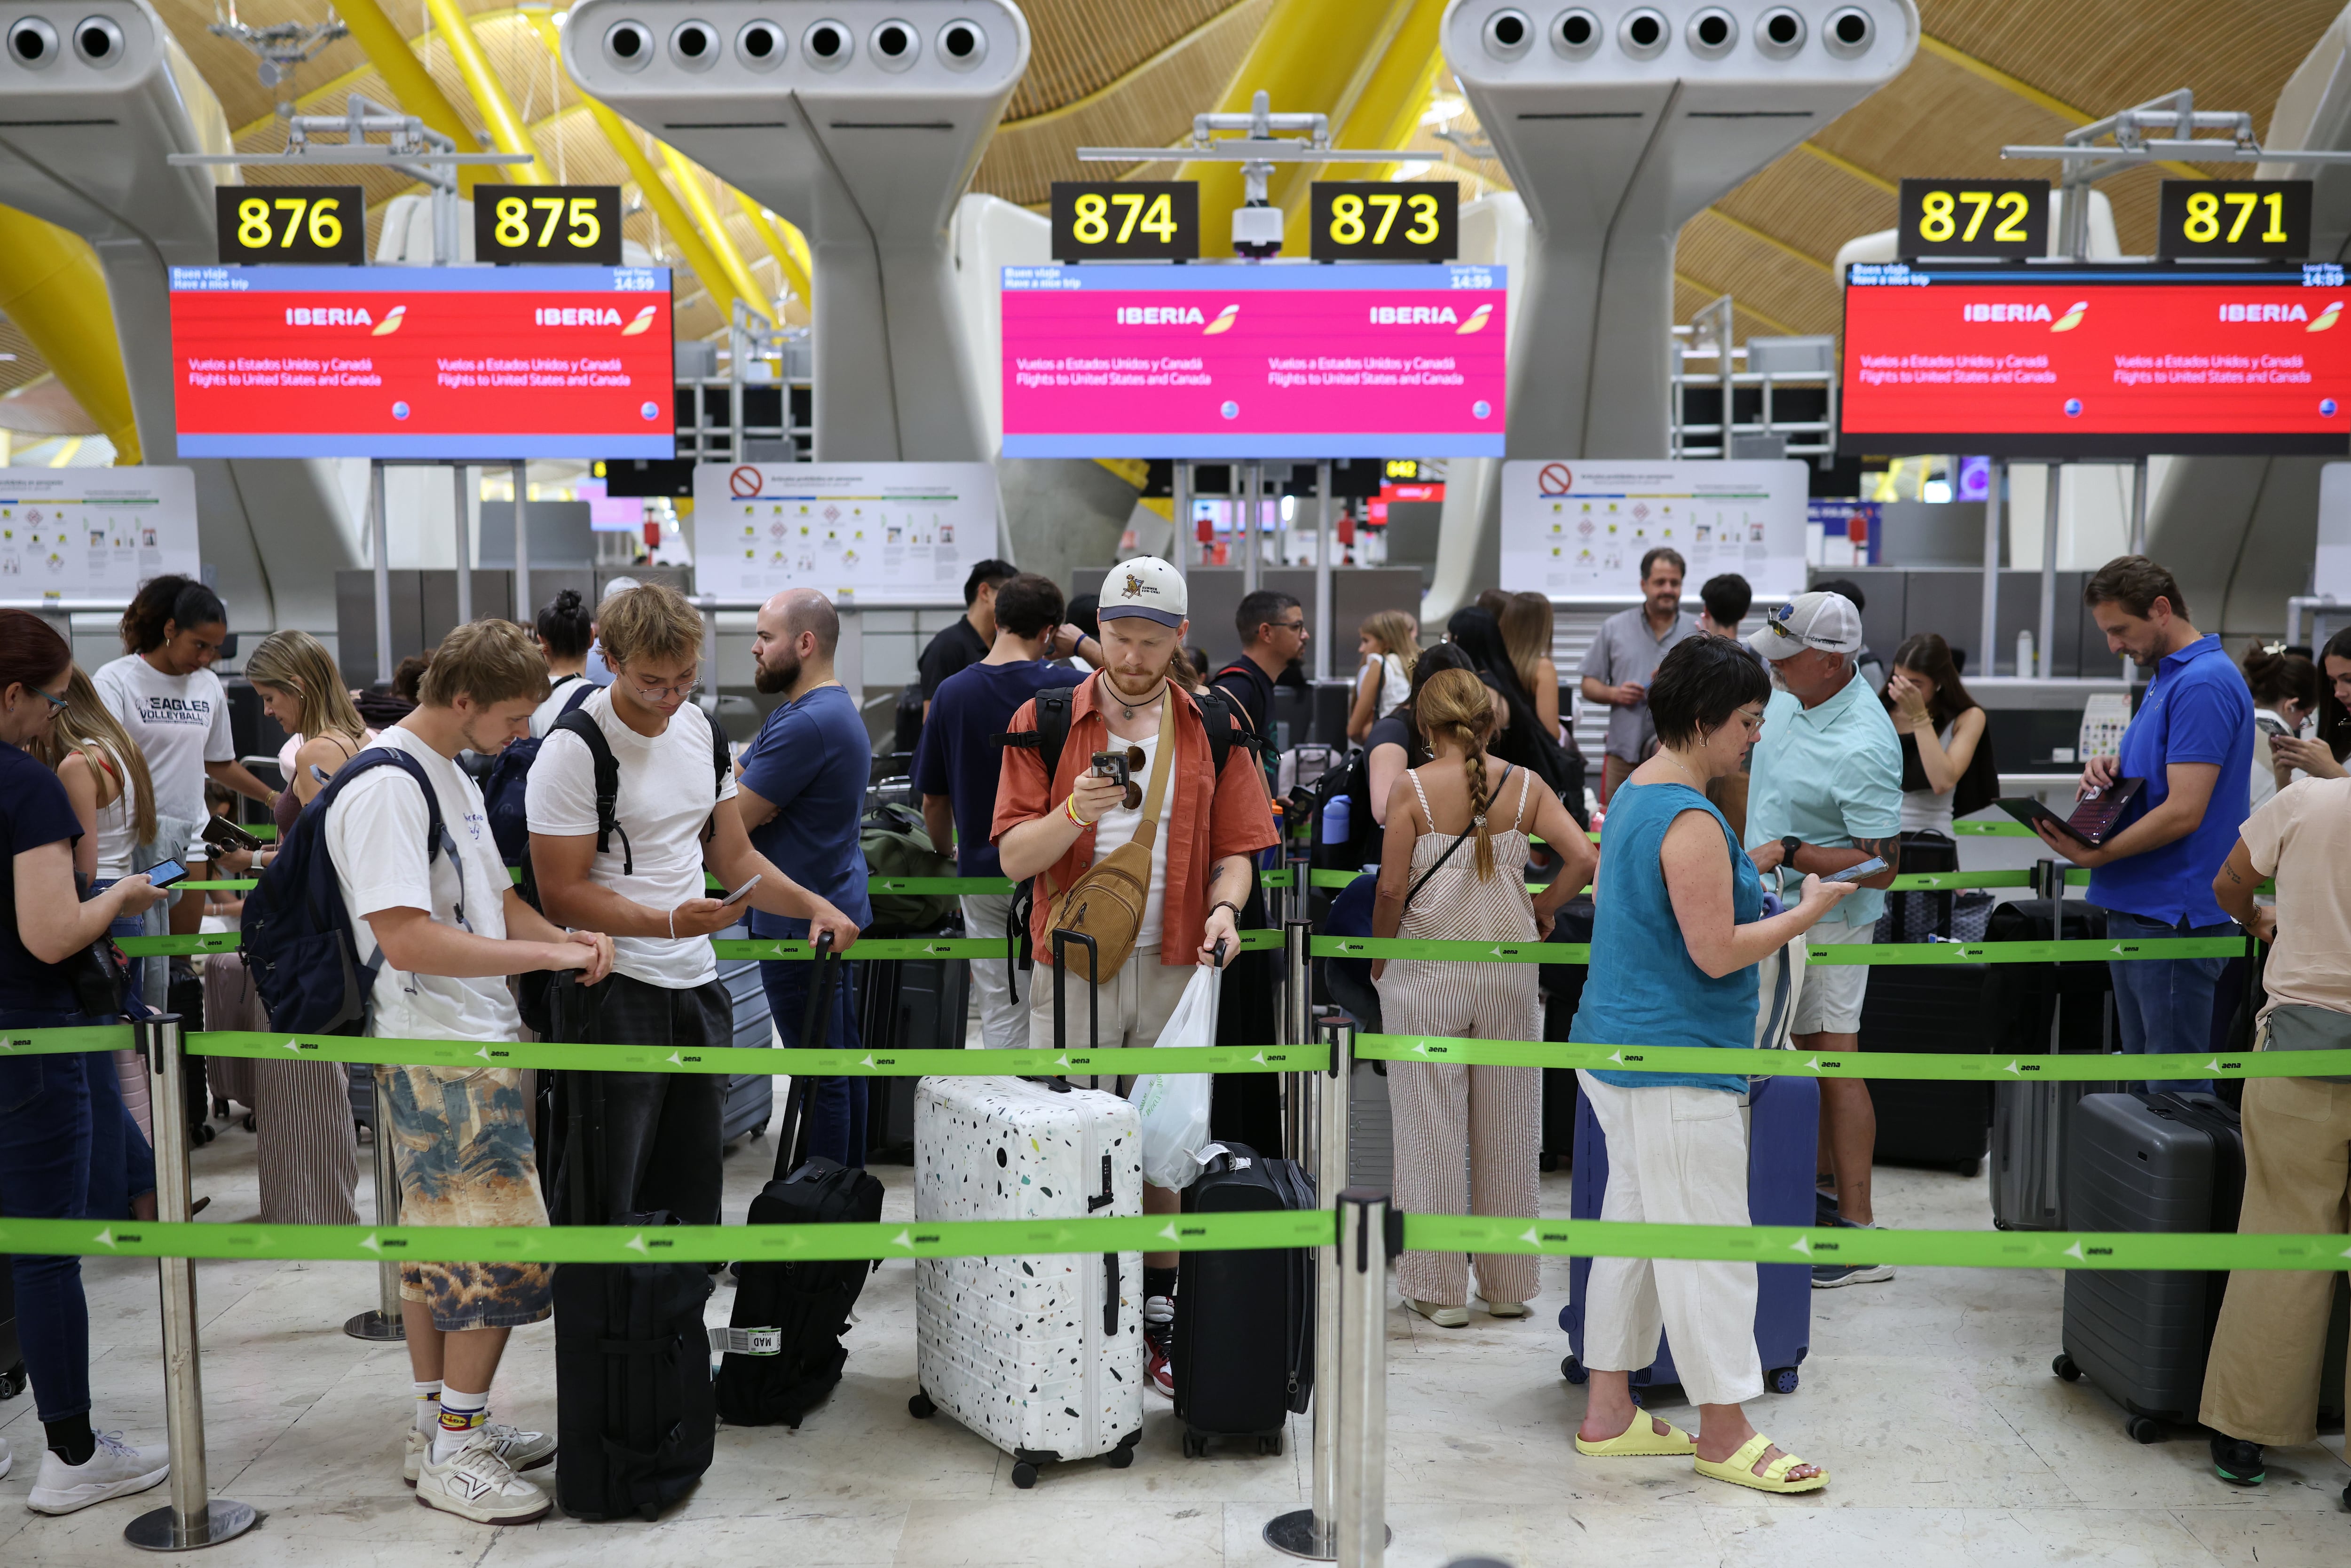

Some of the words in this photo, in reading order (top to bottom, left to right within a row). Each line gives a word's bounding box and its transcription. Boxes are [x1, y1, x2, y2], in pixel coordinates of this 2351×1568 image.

[238, 198, 342, 248] 876
[495, 197, 600, 247] 875
[1073, 194, 1177, 244] 874
[1330, 194, 1439, 244] 873
[1920, 191, 2028, 242] 872
[2184, 193, 2287, 242] 871
[615, 277, 654, 291] 14:59
[1451, 276, 1492, 289] 14:59
[2303, 273, 2344, 286] 14:59
[286, 308, 372, 325] IBERIA
[536, 308, 622, 325] IBERIA
[1117, 307, 1205, 324] IBERIA
[1370, 307, 1457, 324] IBERIA
[1964, 304, 2052, 322] IBERIA
[2220, 304, 2307, 322] IBERIA
[189, 358, 226, 371] Vuelos
[228, 361, 236, 371] a
[237, 358, 280, 371] Estados
[283, 358, 320, 371] Unidos
[322, 361, 330, 373] y
[438, 358, 475, 371] Vuelos
[477, 362, 484, 371] a
[487, 358, 529, 371] Estados
[532, 358, 569, 371] Unidos
[571, 362, 578, 373] y
[1017, 358, 1055, 370] Vuelos
[1057, 361, 1064, 370] a
[1066, 358, 1110, 370] Estados
[1112, 358, 1149, 370] Unidos
[1151, 361, 1159, 372] y
[1269, 357, 1307, 370] Vuelos
[1309, 361, 1316, 370] a
[1318, 357, 1362, 370] Estados
[1364, 357, 1402, 370] Unidos
[1404, 361, 1412, 372] y
[1860, 355, 1898, 368] Vuelos
[1901, 358, 1908, 368] a
[1910, 355, 1954, 368] Estados
[1957, 355, 1994, 368] Unidos
[1996, 358, 2004, 370] y
[2115, 355, 2153, 368] Vuelos
[2155, 358, 2162, 368] a
[2164, 355, 2209, 368] Estados
[2211, 355, 2249, 368] Unidos
[2251, 358, 2259, 370] y
[189, 374, 227, 388] Flights
[229, 374, 241, 386] to
[243, 374, 278, 386] United
[280, 374, 316, 386] States
[318, 374, 339, 386] and
[340, 374, 381, 386] Canada
[438, 374, 475, 389] Flights
[478, 374, 489, 386] to
[492, 374, 528, 386] United
[530, 374, 564, 386] States
[567, 374, 587, 386] and
[590, 374, 631, 386] Canada
[1017, 373, 1055, 388] Flights
[1057, 373, 1069, 386] to
[1071, 373, 1108, 386] United
[1109, 373, 1145, 386] States
[1147, 373, 1168, 386] and
[1170, 373, 1212, 386] Canada
[1269, 372, 1307, 388] Flights
[1309, 372, 1321, 385] to
[1323, 372, 1360, 385] United
[1362, 372, 1398, 385] States
[1399, 372, 1420, 385] and
[1422, 372, 1464, 385] Canada
[1860, 370, 1899, 386] Flights
[1901, 370, 1912, 383] to
[1914, 370, 1951, 383] United
[1954, 370, 1989, 383] States
[1991, 370, 2012, 383] and
[2014, 370, 2056, 383] Canada
[2114, 370, 2152, 386] Flights
[2154, 370, 2167, 383] to
[2169, 370, 2206, 383] United
[2208, 370, 2243, 383] States
[2246, 370, 2267, 383] and
[2269, 370, 2312, 383] Canada
[150, 697, 210, 713] EAGLES
[140, 710, 203, 721] VOLLEYBALL
[754, 1337, 771, 1347] MAD
